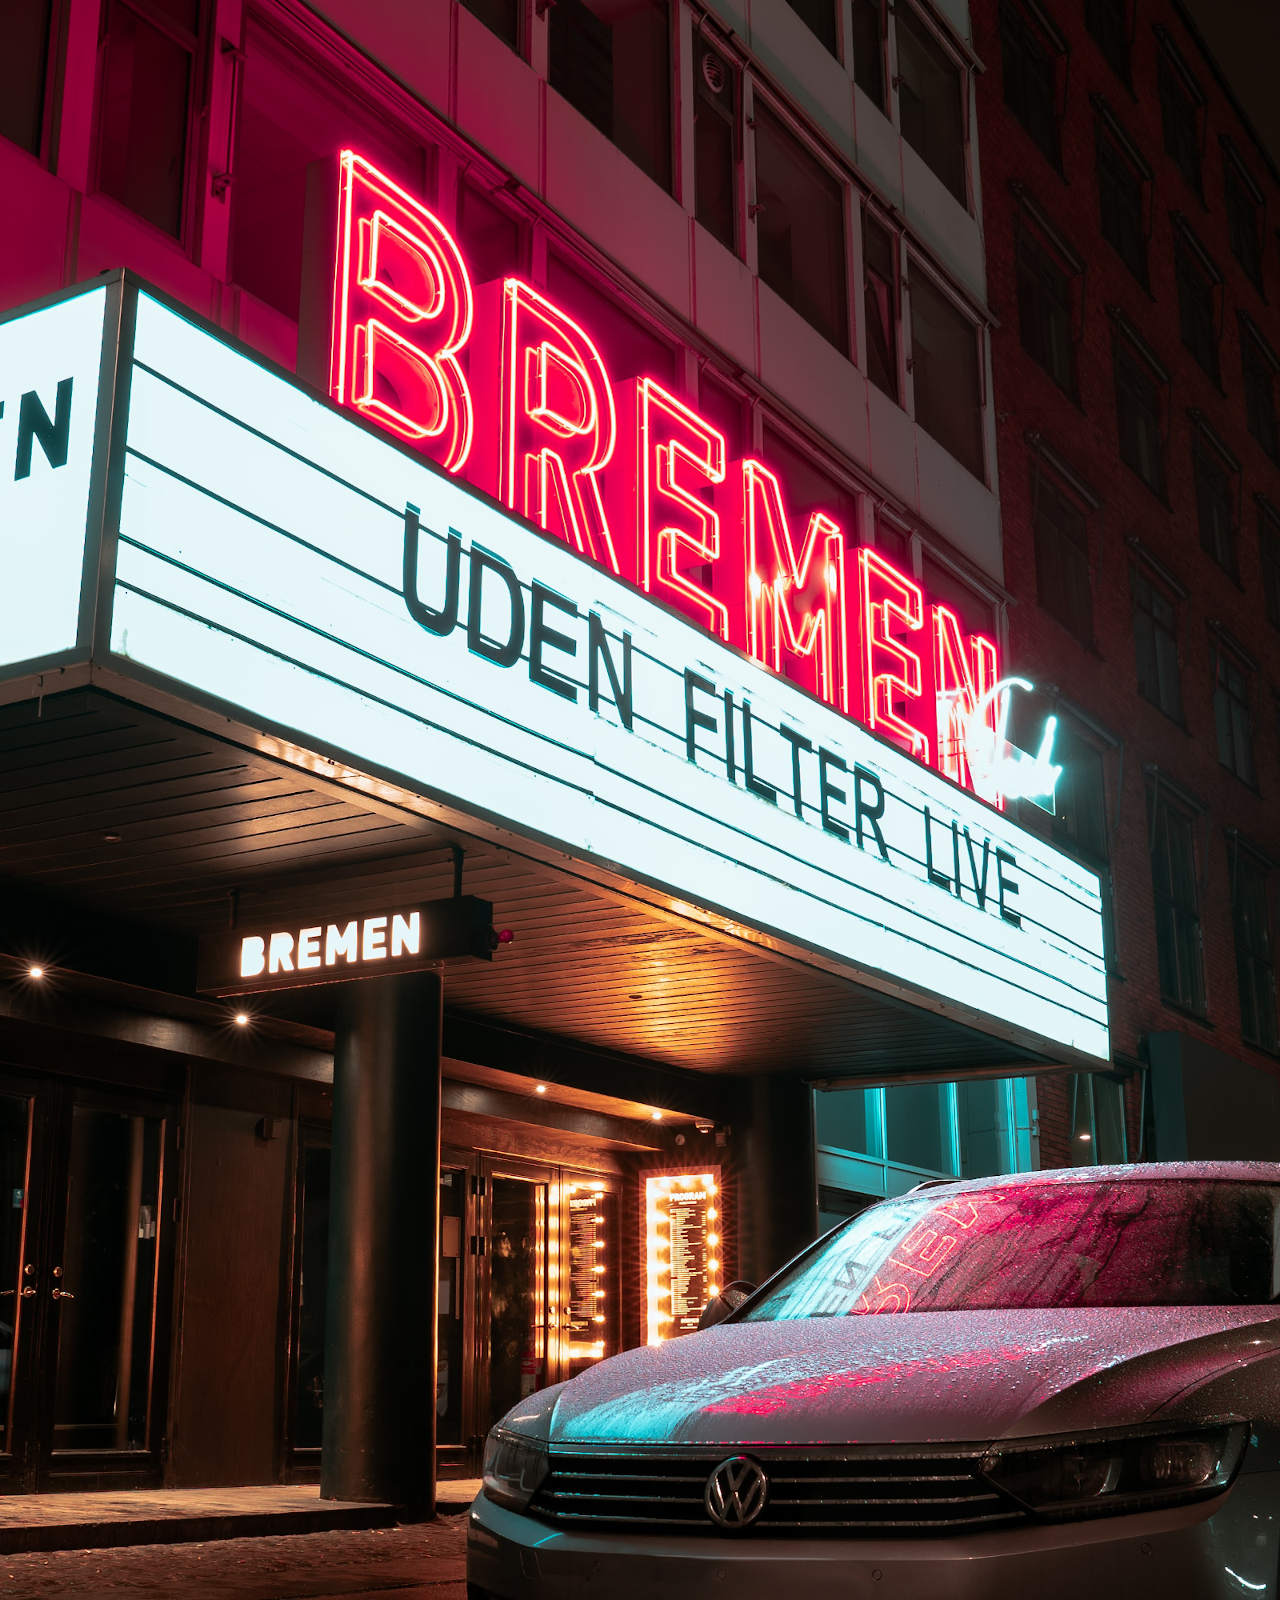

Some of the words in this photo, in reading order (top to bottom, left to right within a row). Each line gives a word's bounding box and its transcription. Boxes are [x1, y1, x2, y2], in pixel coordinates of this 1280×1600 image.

[0, 376, 74, 481] N
[329, 148, 1005, 812] BREMEN
[403, 501, 633, 730] UDEN
[684, 665, 889, 862] FILTER
[924, 806, 1022, 928] LIVE
[240, 911, 420, 978] BREMEN
